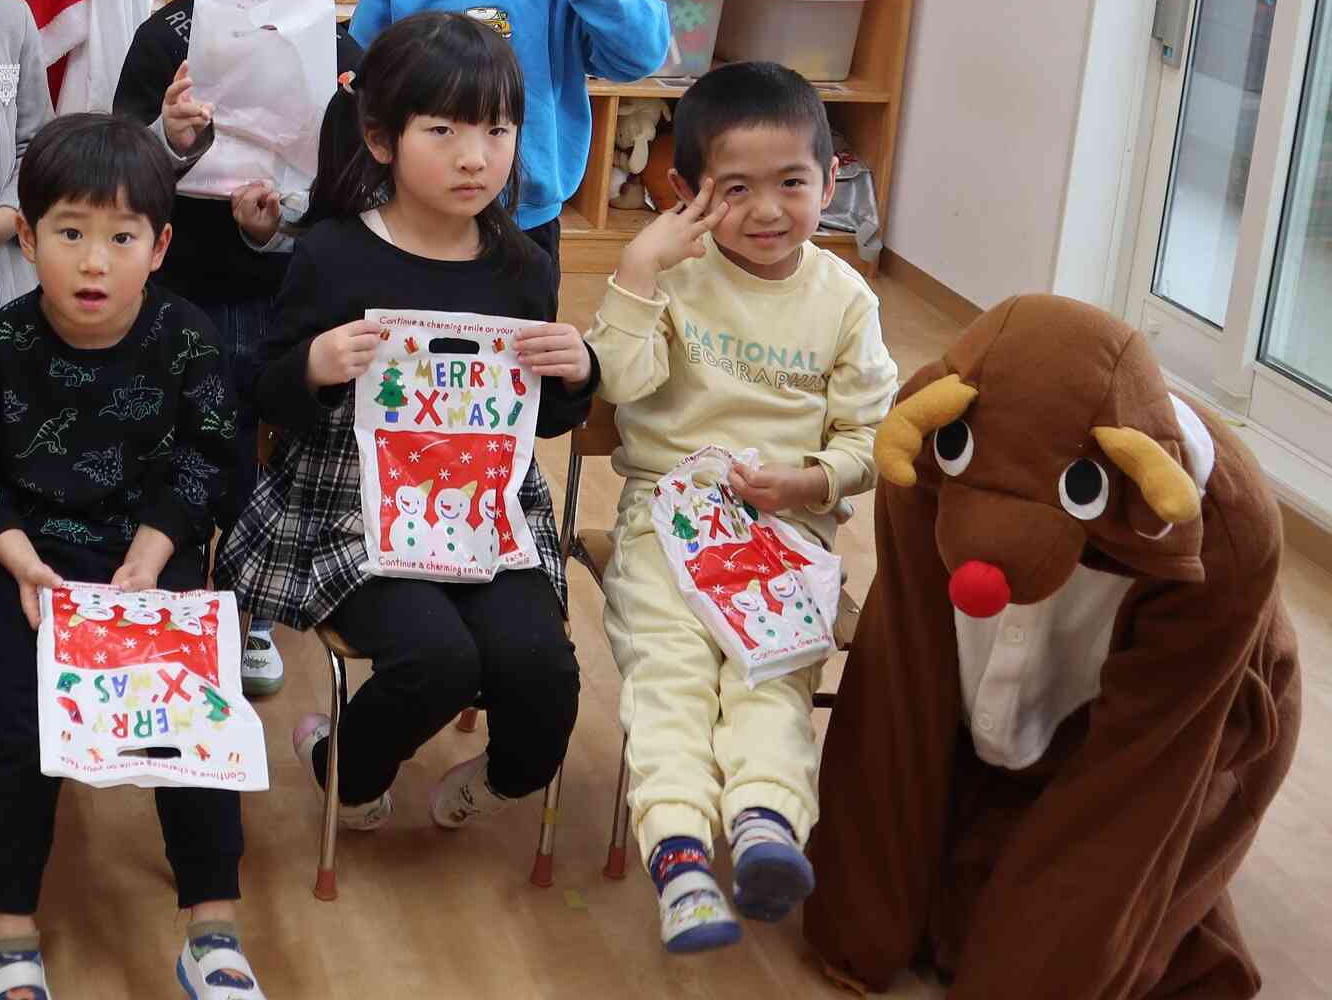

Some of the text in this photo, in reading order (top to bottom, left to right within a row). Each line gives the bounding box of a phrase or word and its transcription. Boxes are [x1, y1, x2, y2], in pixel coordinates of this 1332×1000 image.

[379, 316, 417, 327] Continue
[426, 321, 461, 335] charming
[683, 318, 821, 373] NATIONAL
[414, 360, 502, 389] MERRY
[378, 555, 416, 569] Continue
[426, 561, 462, 577] charming
[92, 707, 195, 739] MERRY
